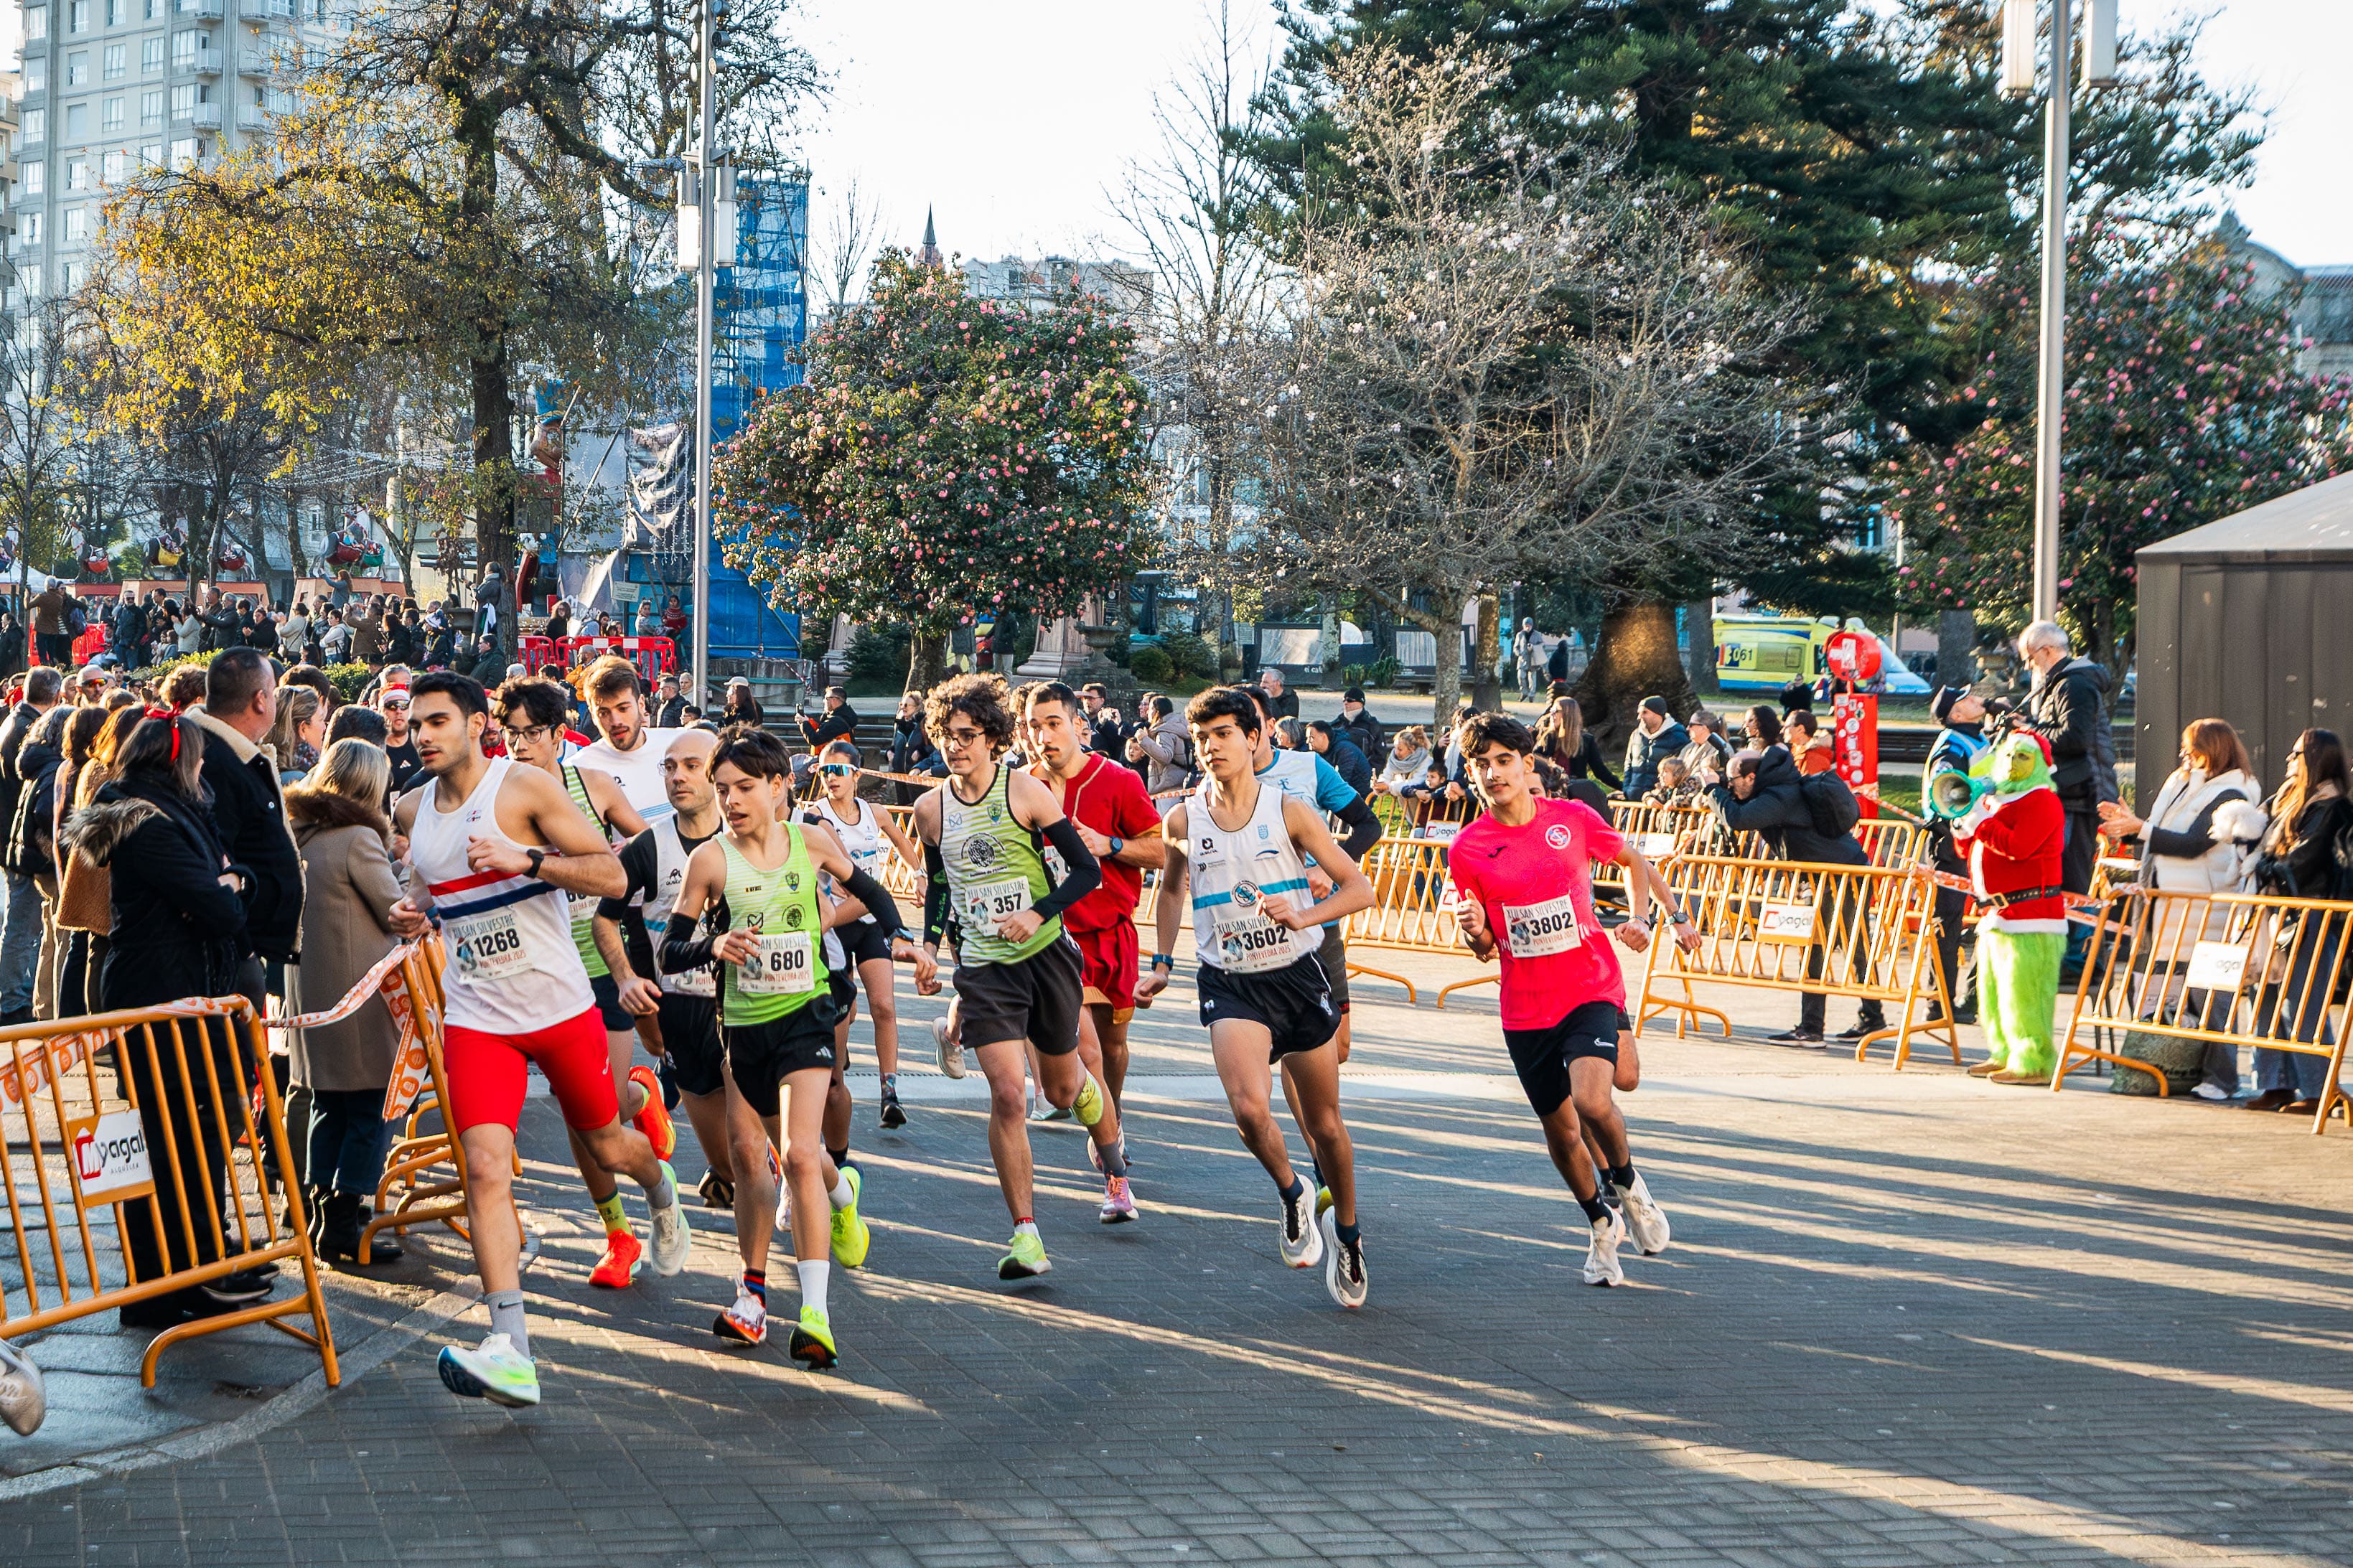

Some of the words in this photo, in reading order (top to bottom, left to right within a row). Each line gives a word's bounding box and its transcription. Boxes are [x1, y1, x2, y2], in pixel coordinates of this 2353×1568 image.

[979, 886, 993, 897] SAN
[993, 881, 1024, 895] SILVESTRE
[993, 893, 1021, 914] 357
[1520, 907, 1534, 919] SAN
[1535, 900, 1568, 916] SILVESTRE
[461, 924, 477, 936] SAN
[477, 914, 516, 934] SILVESTRE
[1216, 921, 1230, 934] XLII
[1230, 918, 1248, 931] SAN
[1530, 912, 1573, 936] 3802
[474, 928, 520, 957] 1268
[774, 935, 808, 949] SILVESTRE
[1242, 925, 1289, 951] 3602
[1533, 934, 1563, 946] PONTEVEDRA
[1564, 931, 1574, 940] 2025
[479, 955, 512, 969] PONTEVEDRA
[513, 949, 527, 961] 2025
[770, 949, 804, 972] 680
[1246, 949, 1278, 962] PONTEVEDRA
[1278, 945, 1291, 956] 2025
[764, 972, 797, 982] PONTEVEDRA
[798, 970, 810, 980] 2025
